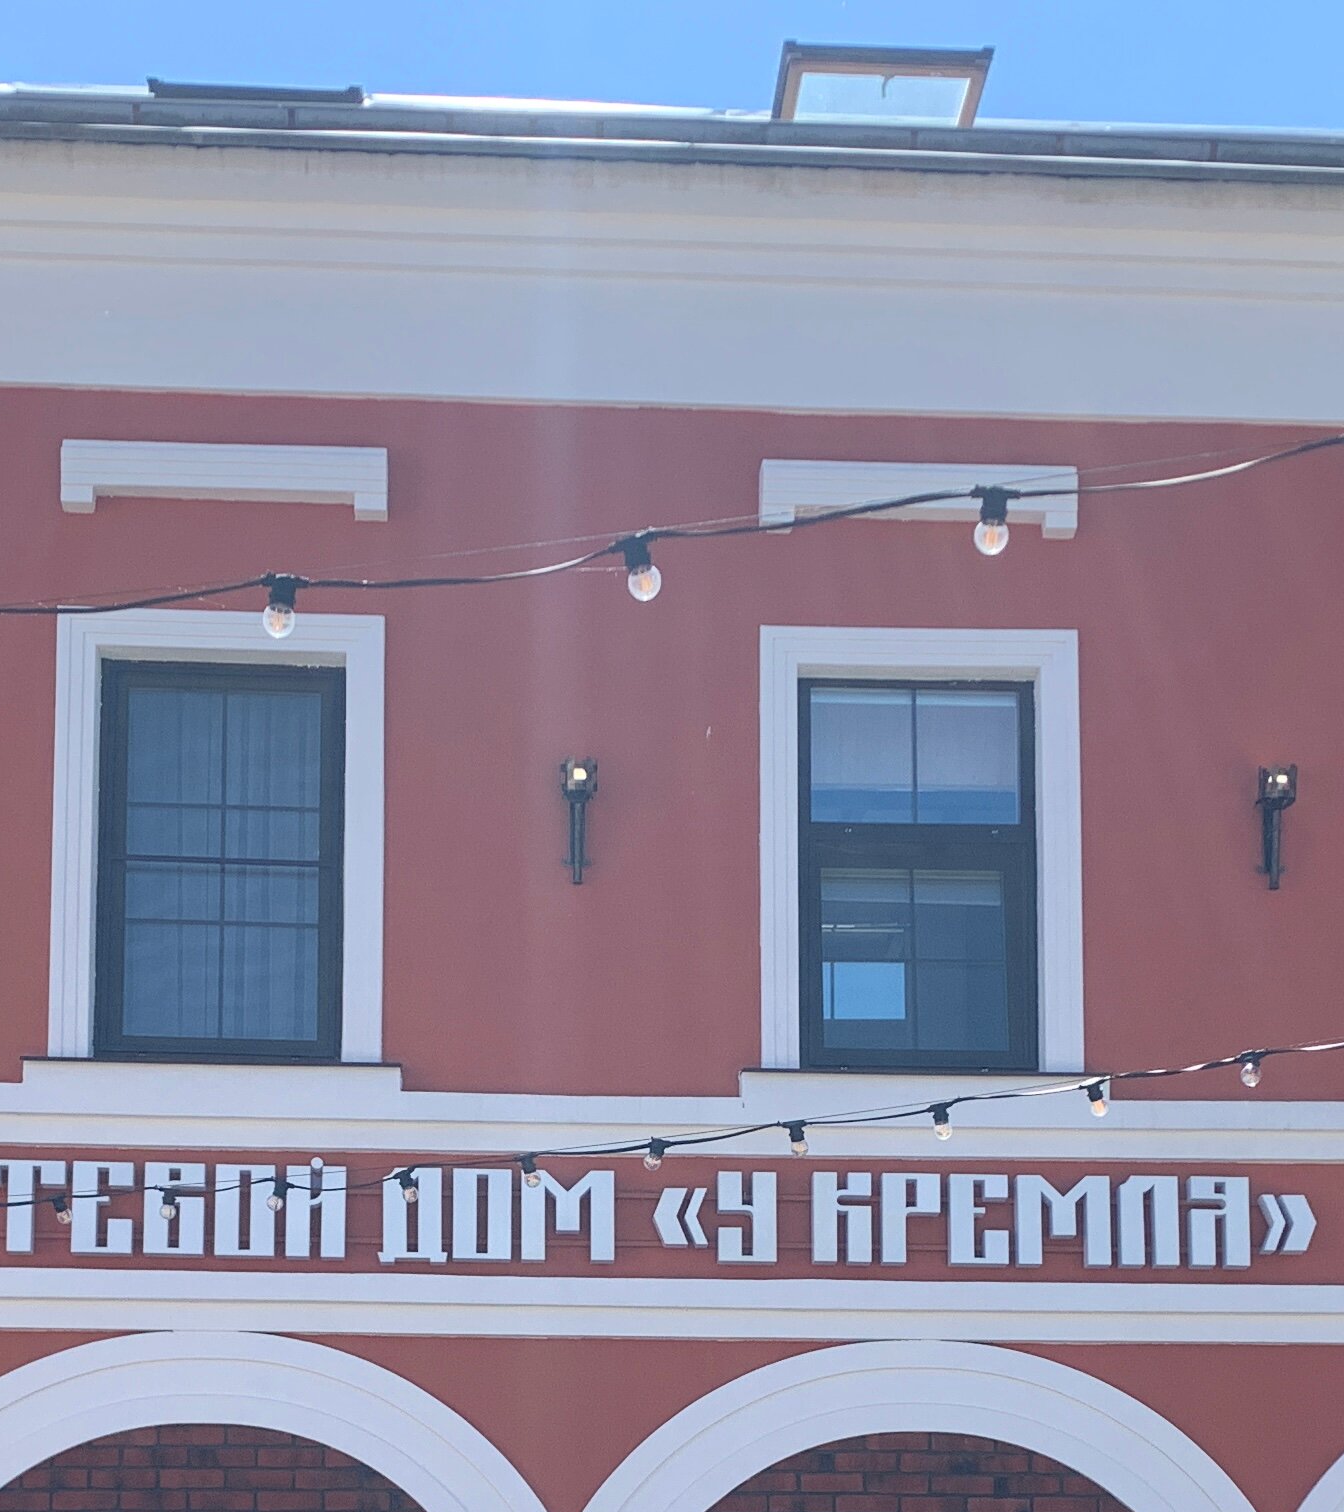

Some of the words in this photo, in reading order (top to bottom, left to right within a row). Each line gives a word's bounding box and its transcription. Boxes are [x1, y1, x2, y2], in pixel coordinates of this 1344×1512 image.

[377, 1165, 615, 1265] ДОМ
[652, 1170, 778, 1265] «У
[811, 1170, 1317, 1269] КРЕМЛЯ»
